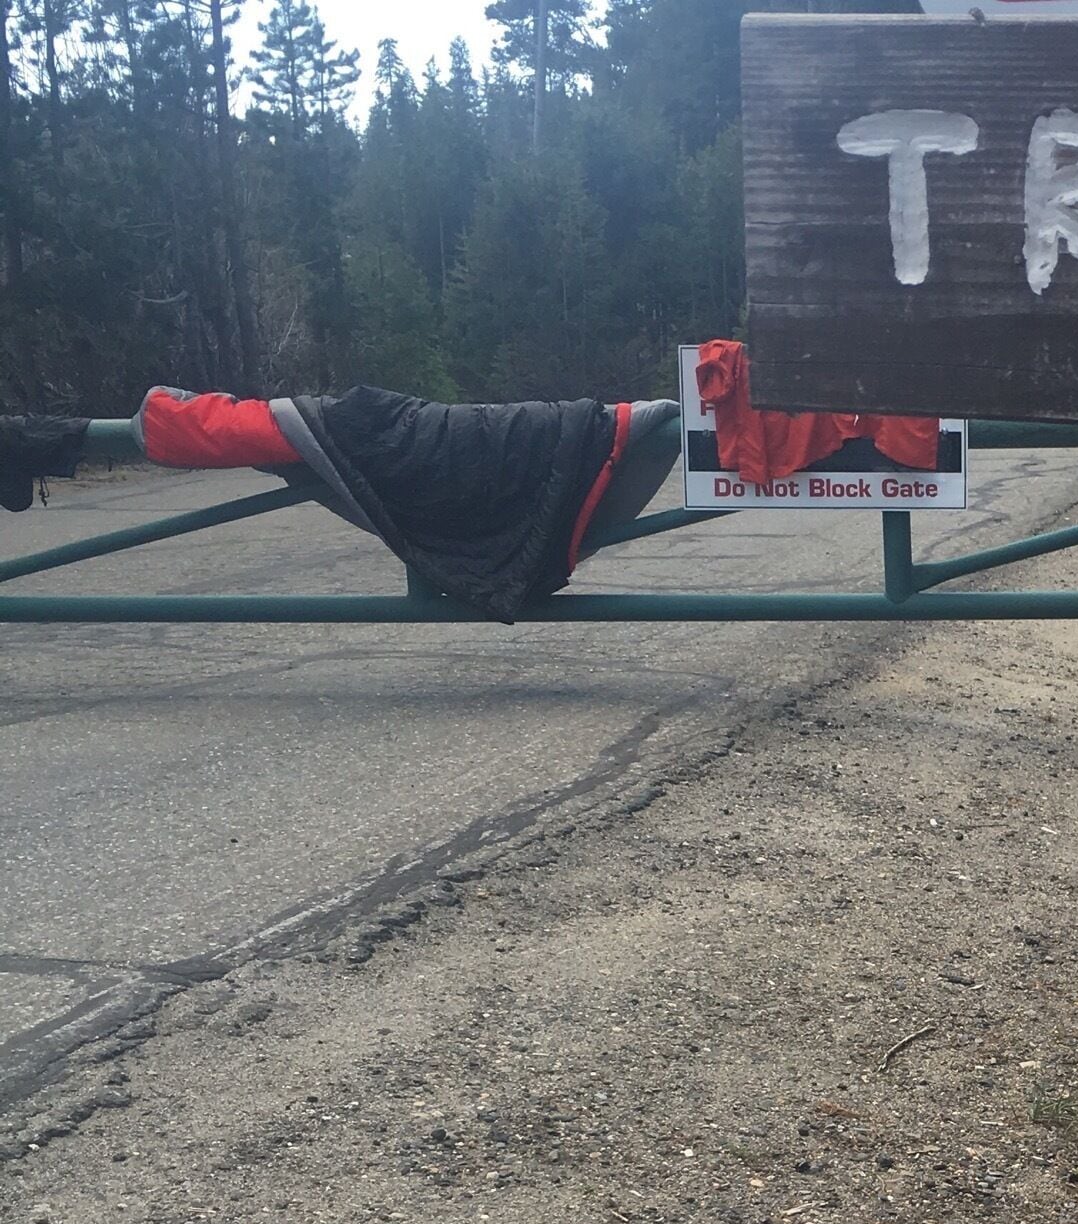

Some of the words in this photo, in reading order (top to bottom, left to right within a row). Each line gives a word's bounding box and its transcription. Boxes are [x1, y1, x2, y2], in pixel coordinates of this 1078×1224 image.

[713, 478, 746, 497] Do
[755, 478, 800, 497] Not
[808, 478, 872, 498] Block
[881, 478, 939, 498] Gate
